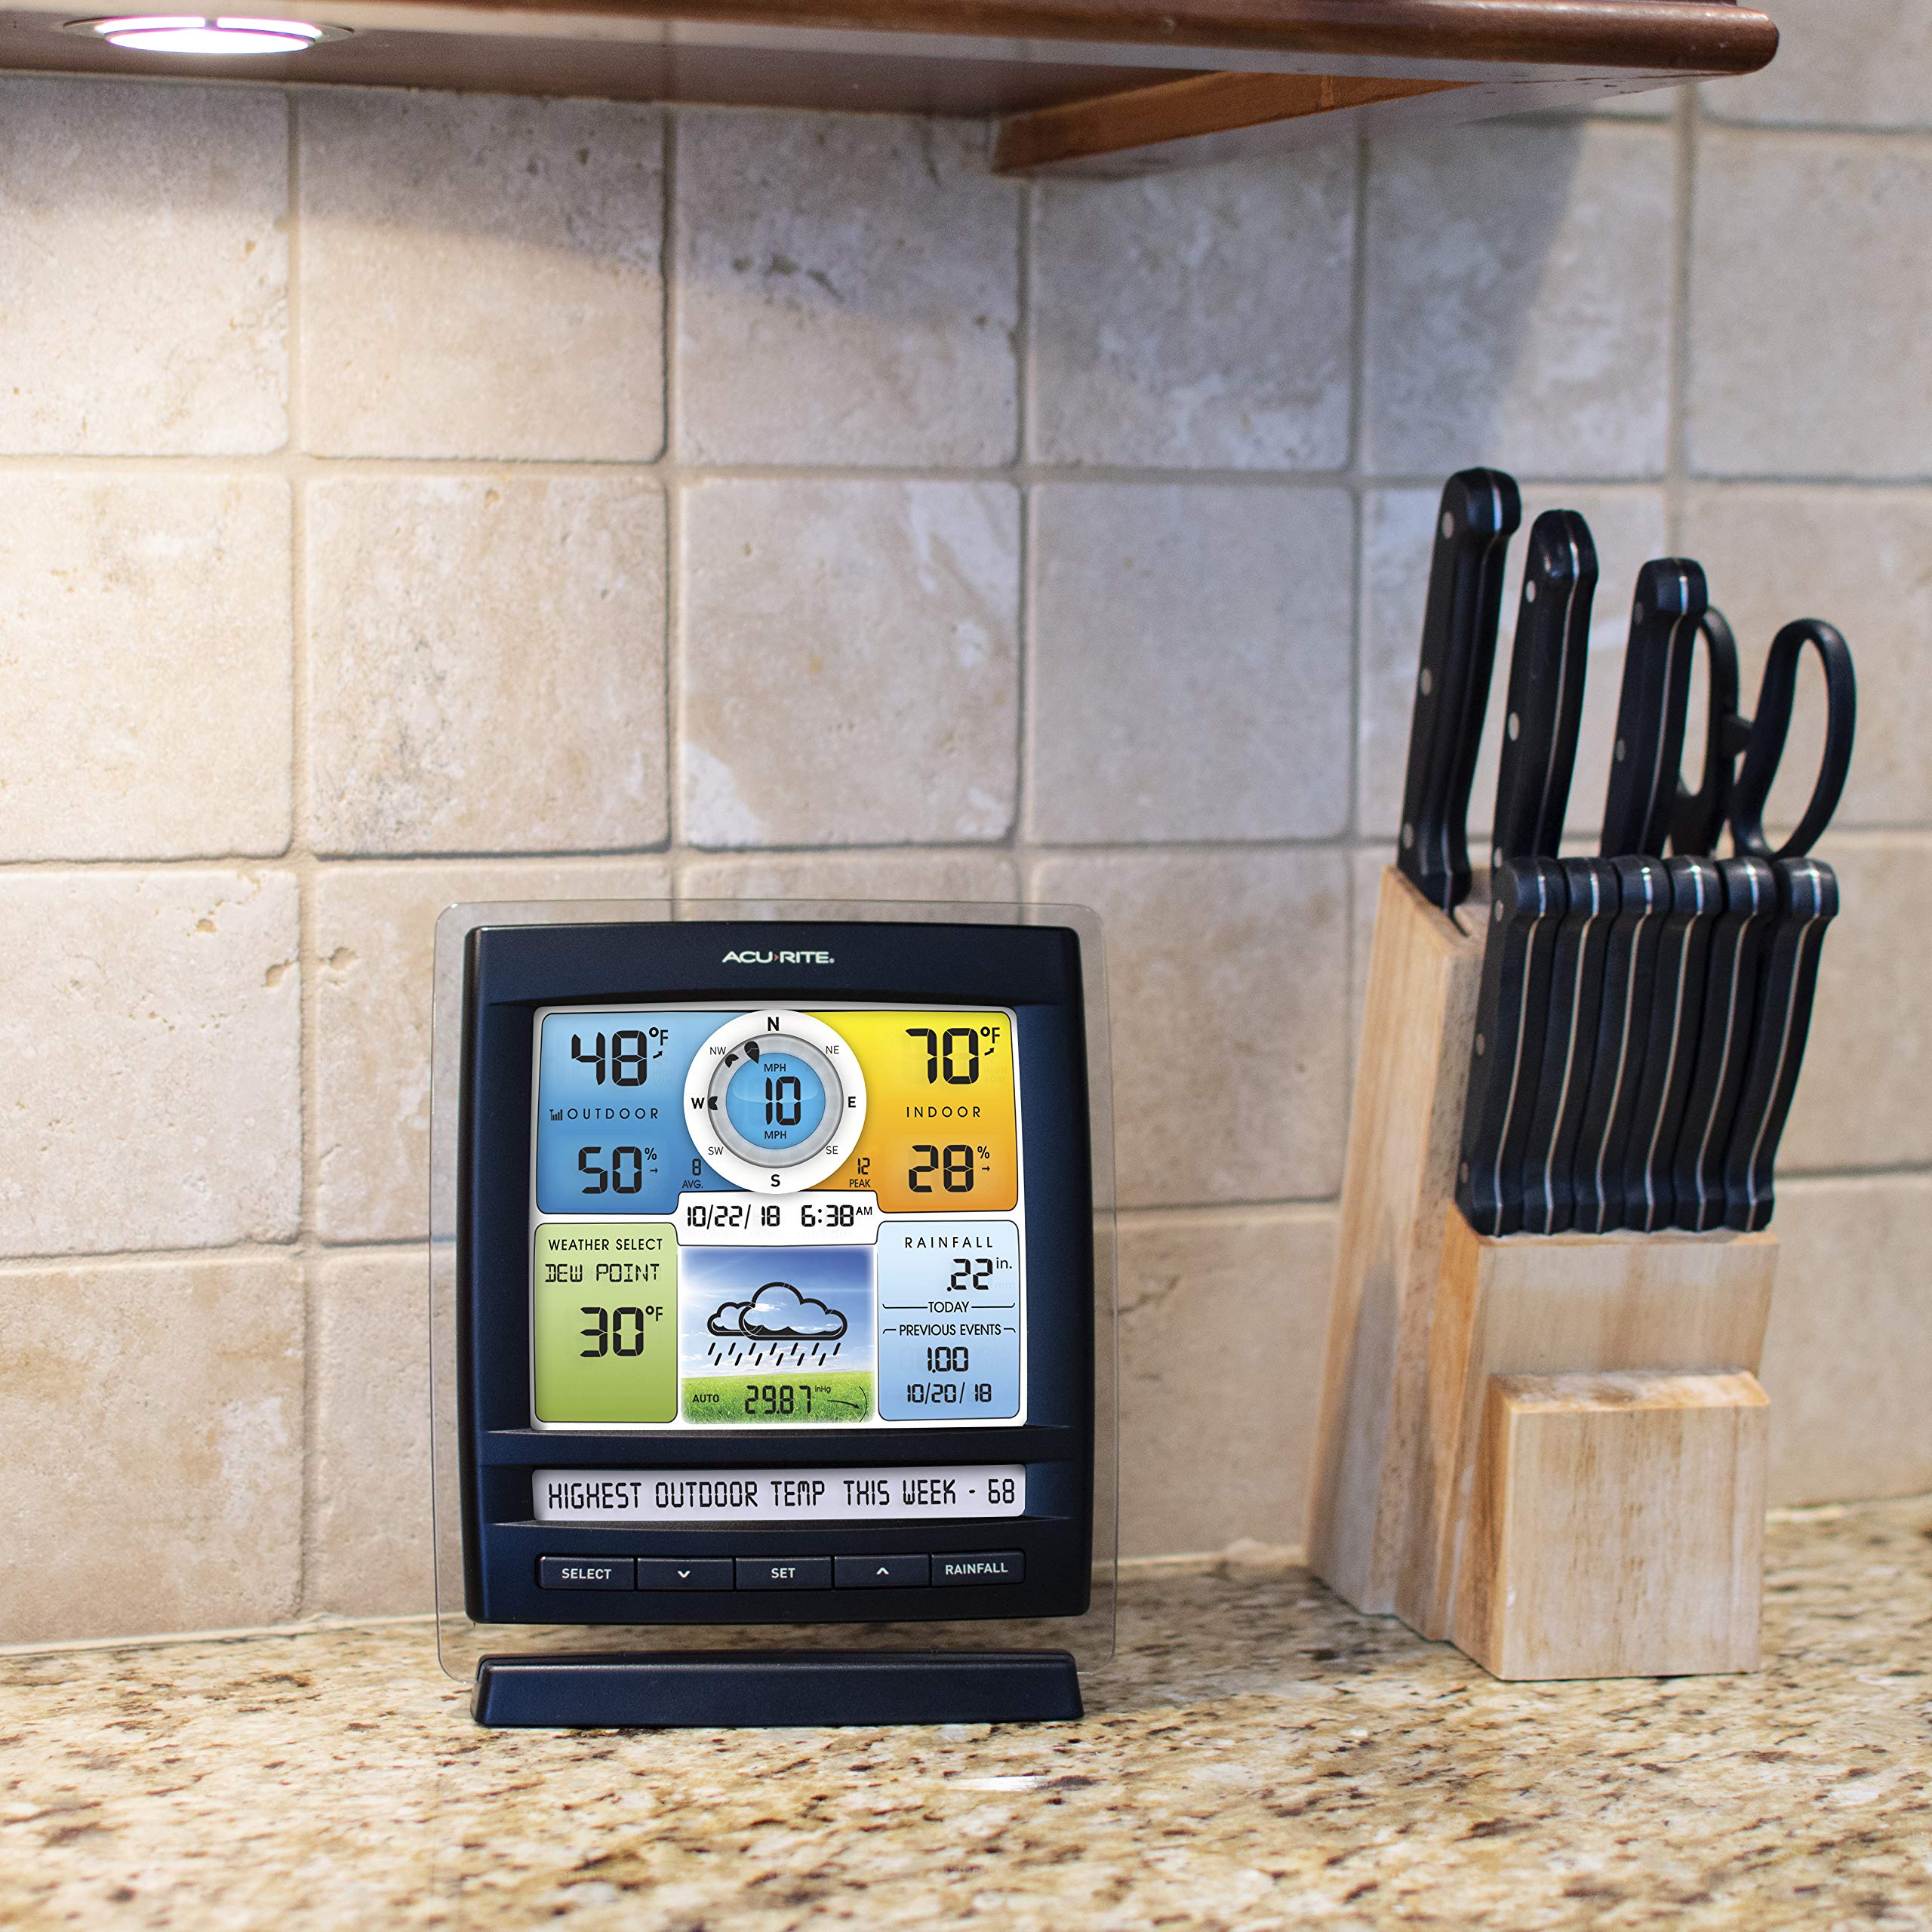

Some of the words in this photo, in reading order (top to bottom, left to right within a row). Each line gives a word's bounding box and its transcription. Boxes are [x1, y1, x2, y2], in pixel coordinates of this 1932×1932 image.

[768, 1017, 780, 1032] N
[709, 1046, 727, 1056] NW
[826, 1045, 839, 1055] NE
[764, 1063, 786, 1072] MPH
[691, 1097, 705, 1109] W
[765, 1076, 801, 1126] 10
[848, 1096, 857, 1109] E
[567, 1108, 658, 1120] OUTDOOR
[906, 1106, 980, 1118] INDOOR
[764, 1131, 787, 1140] MPH
[708, 1146, 724, 1156] SW
[826, 1145, 838, 1155] SE
[692, 1158, 701, 1176] 8
[857, 1158, 870, 1175] 12
[681, 1179, 703, 1189] AVG.
[771, 1174, 780, 1187] S
[849, 1179, 871, 1188] PEAK
[548, 1239, 609, 1251] WEATHER
[615, 1238, 663, 1251] SELECT
[906, 1237, 993, 1248] RAINFALL
[545, 1263, 583, 1282] DEW
[596, 1263, 660, 1282] POINT
[928, 1301, 970, 1313] TODAY
[900, 1324, 956, 1336] PREVIOUS
[960, 1324, 1001, 1336] EVENTS
[927, 1346, 969, 1374] 1.00
[693, 1394, 719, 1403] AUTO
[745, 1385, 811, 1414] 29.87
[549, 1482, 641, 1509] HIGHEST
[655, 1481, 758, 1508] OUTDOOR
[771, 1481, 825, 1506] TEMP
[843, 1480, 890, 1506] THIS
[903, 1479, 956, 1505] WEEK
[988, 1478, 1015, 1504] 68
[561, 1568, 612, 1580] SELECT
[771, 1567, 796, 1579] SET
[945, 1562, 1008, 1576] RAINFALL
